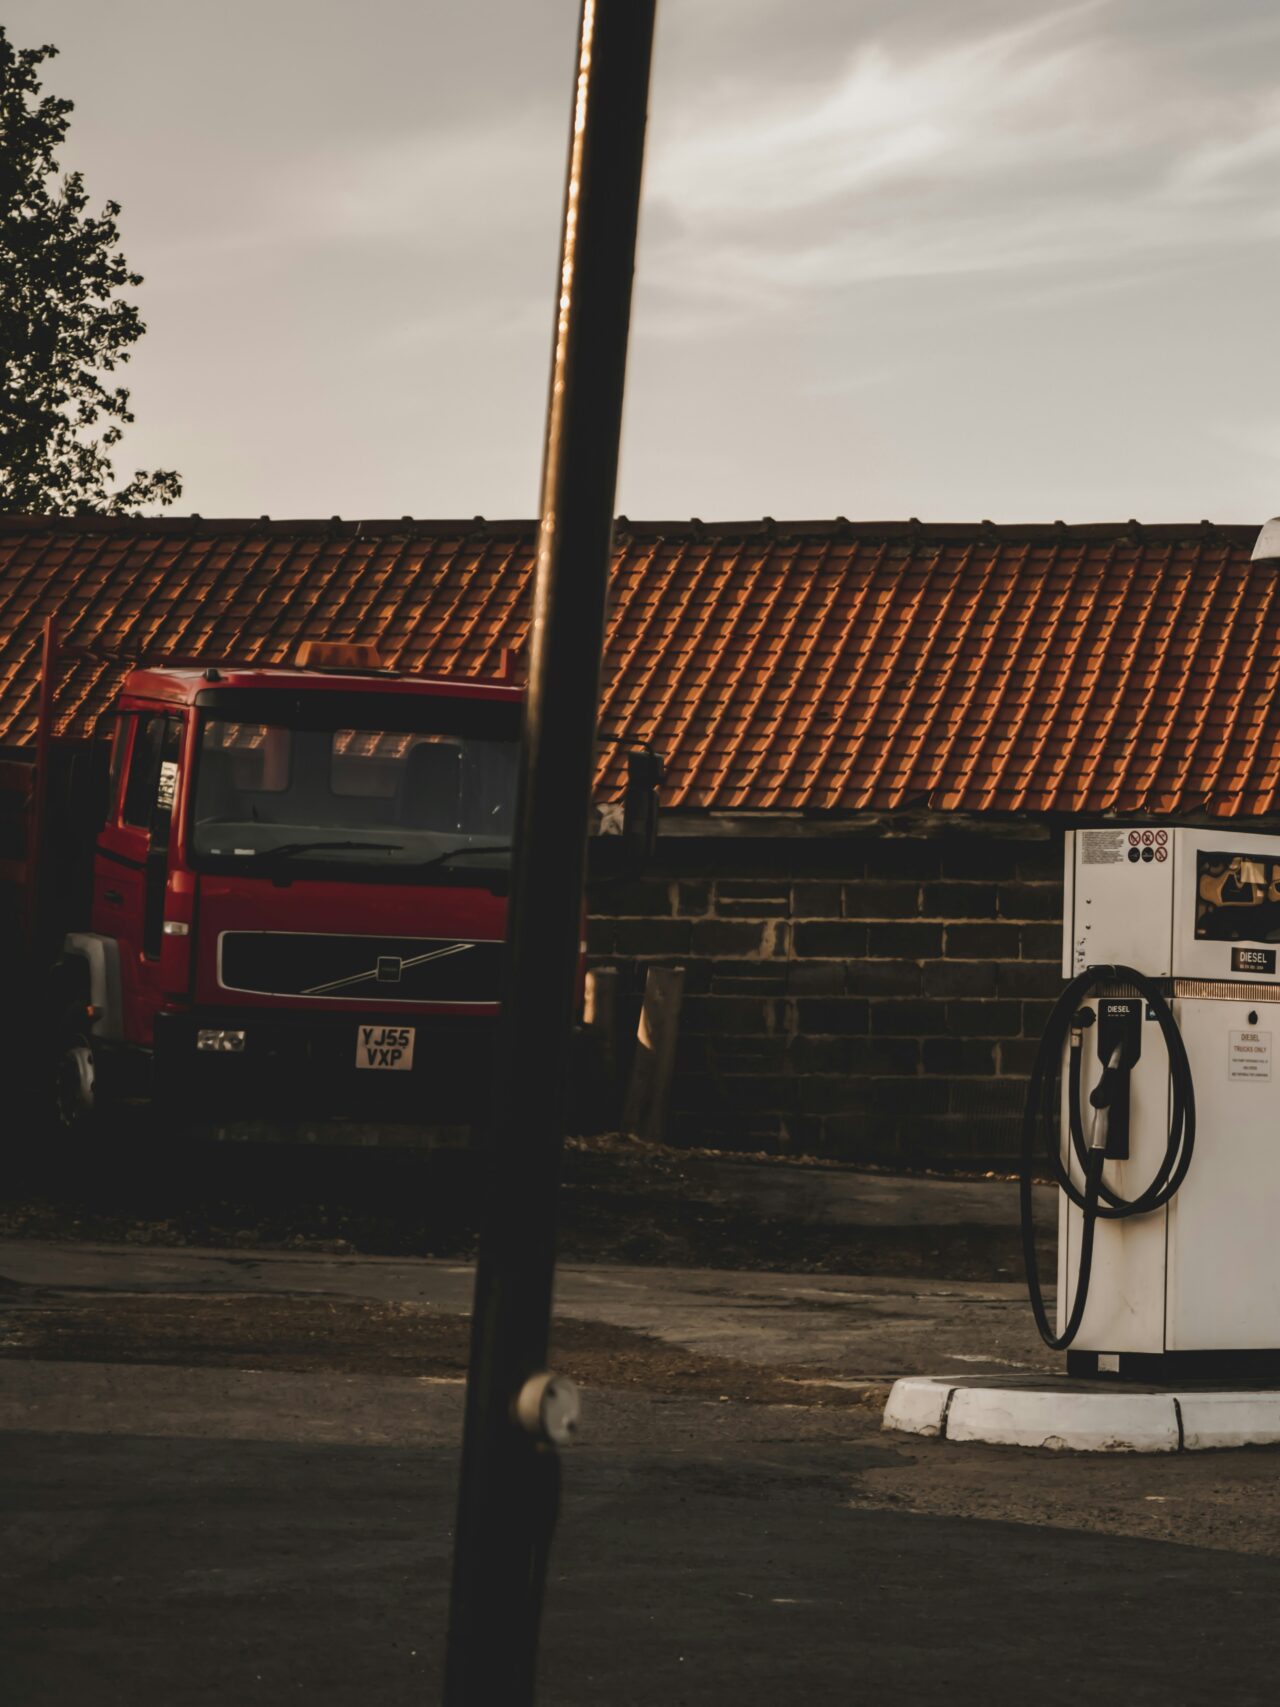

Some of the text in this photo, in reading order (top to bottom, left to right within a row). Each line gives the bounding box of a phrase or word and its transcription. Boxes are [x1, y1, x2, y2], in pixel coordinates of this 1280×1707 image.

[1240, 951, 1267, 964] DIESEL
[1107, 1005, 1130, 1013] DIESEL
[362, 1028, 410, 1047] YJ55
[1241, 1033, 1260, 1042] DIESEL
[367, 1047, 402, 1066] VXP
